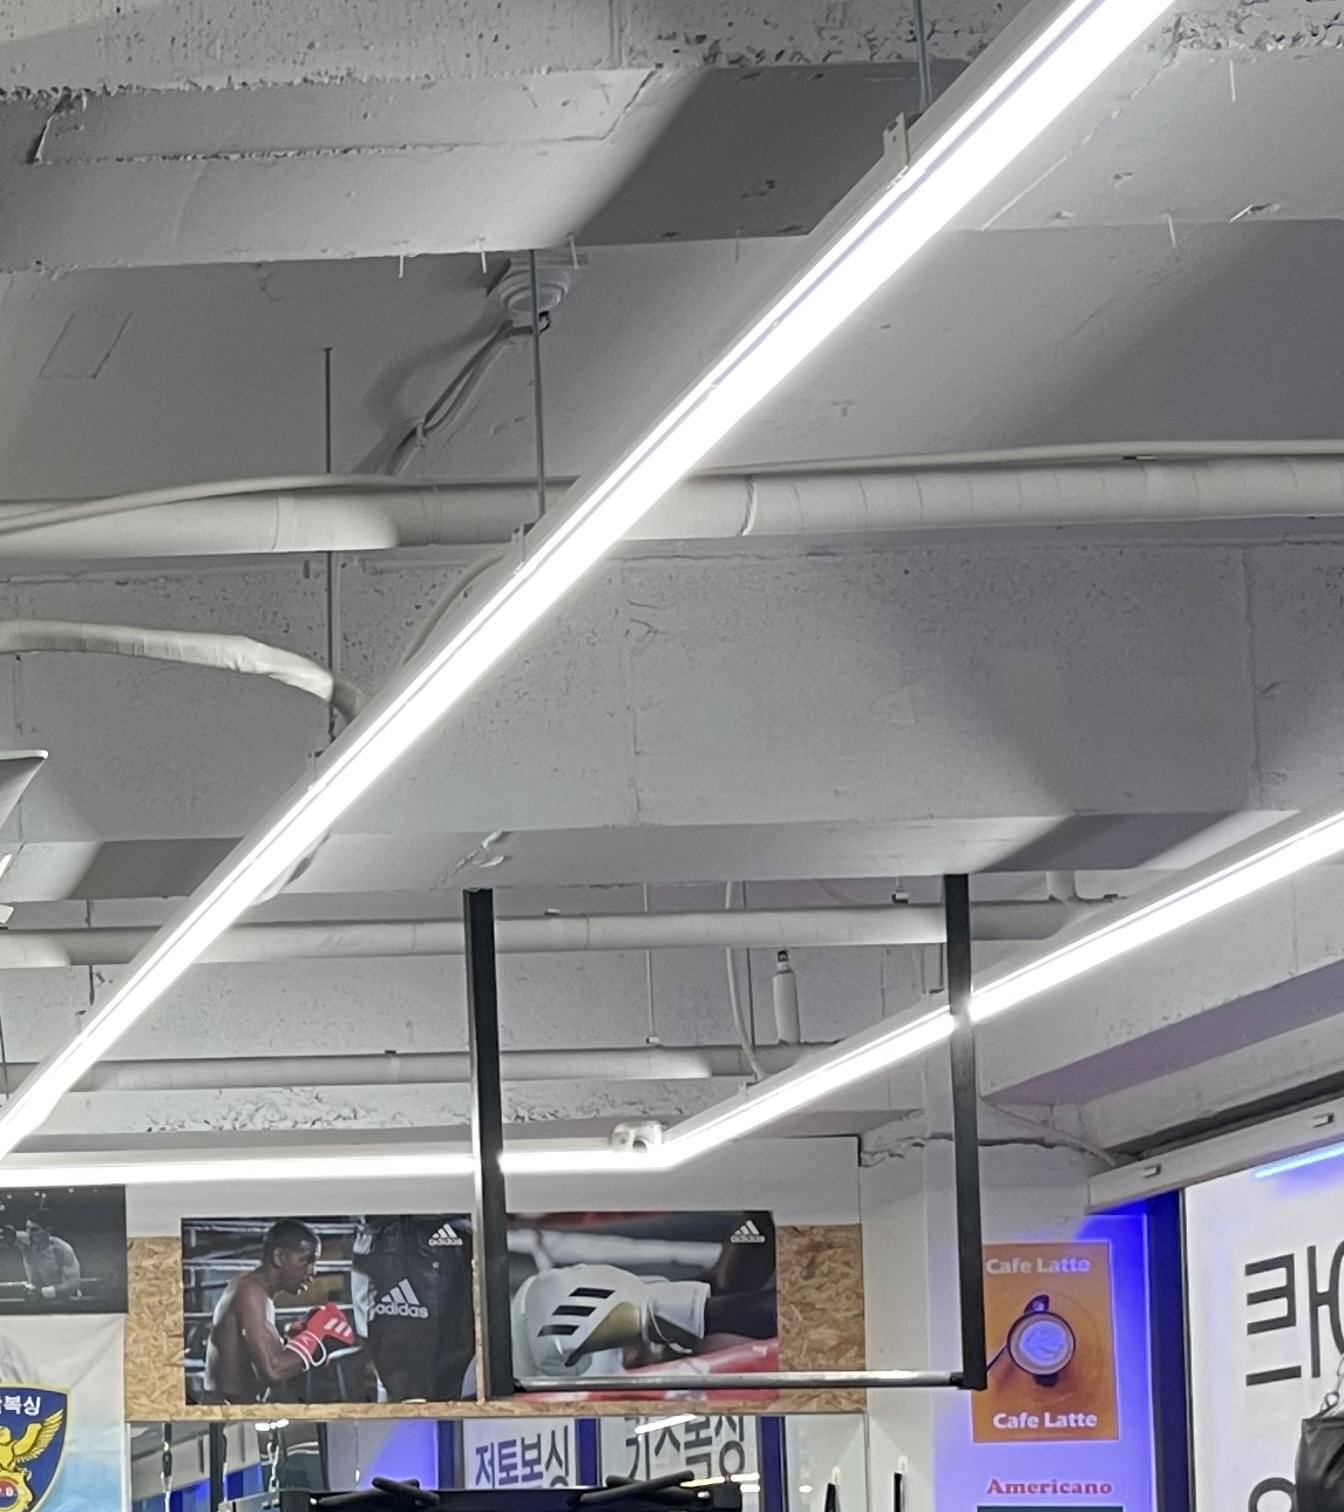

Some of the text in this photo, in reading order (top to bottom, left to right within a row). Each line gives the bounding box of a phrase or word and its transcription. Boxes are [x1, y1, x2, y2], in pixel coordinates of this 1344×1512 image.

[986, 1256, 1091, 1275] Cafe Latte
[374, 1301, 429, 1319] adidas
[992, 1411, 1098, 1429] Cafe Latte
[986, 1479, 1113, 1495] Americano
